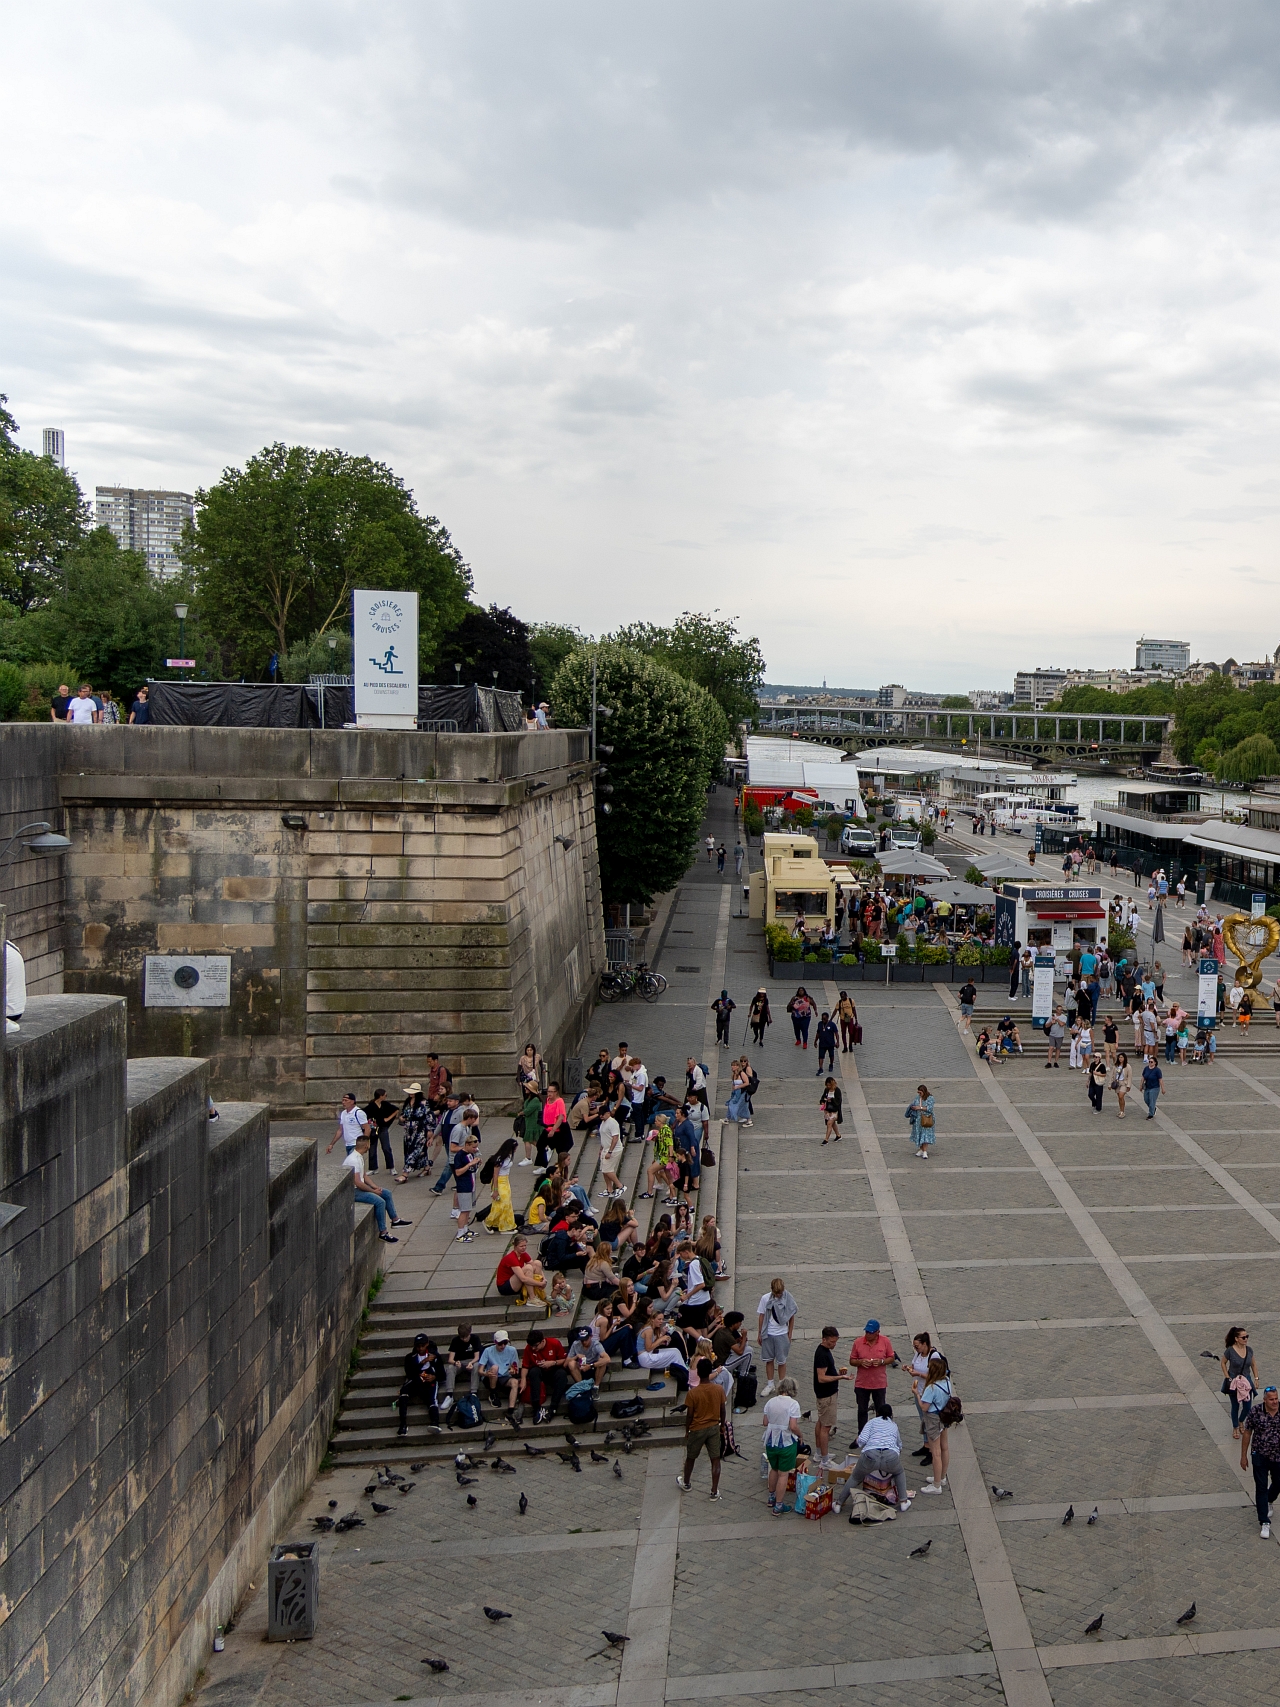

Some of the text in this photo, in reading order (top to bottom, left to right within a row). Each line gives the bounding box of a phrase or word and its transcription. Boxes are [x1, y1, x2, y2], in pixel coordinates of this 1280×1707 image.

[371, 622, 400, 634] CRUISES
[1035, 889, 1089, 898] CROISIÈRES CRUISES
